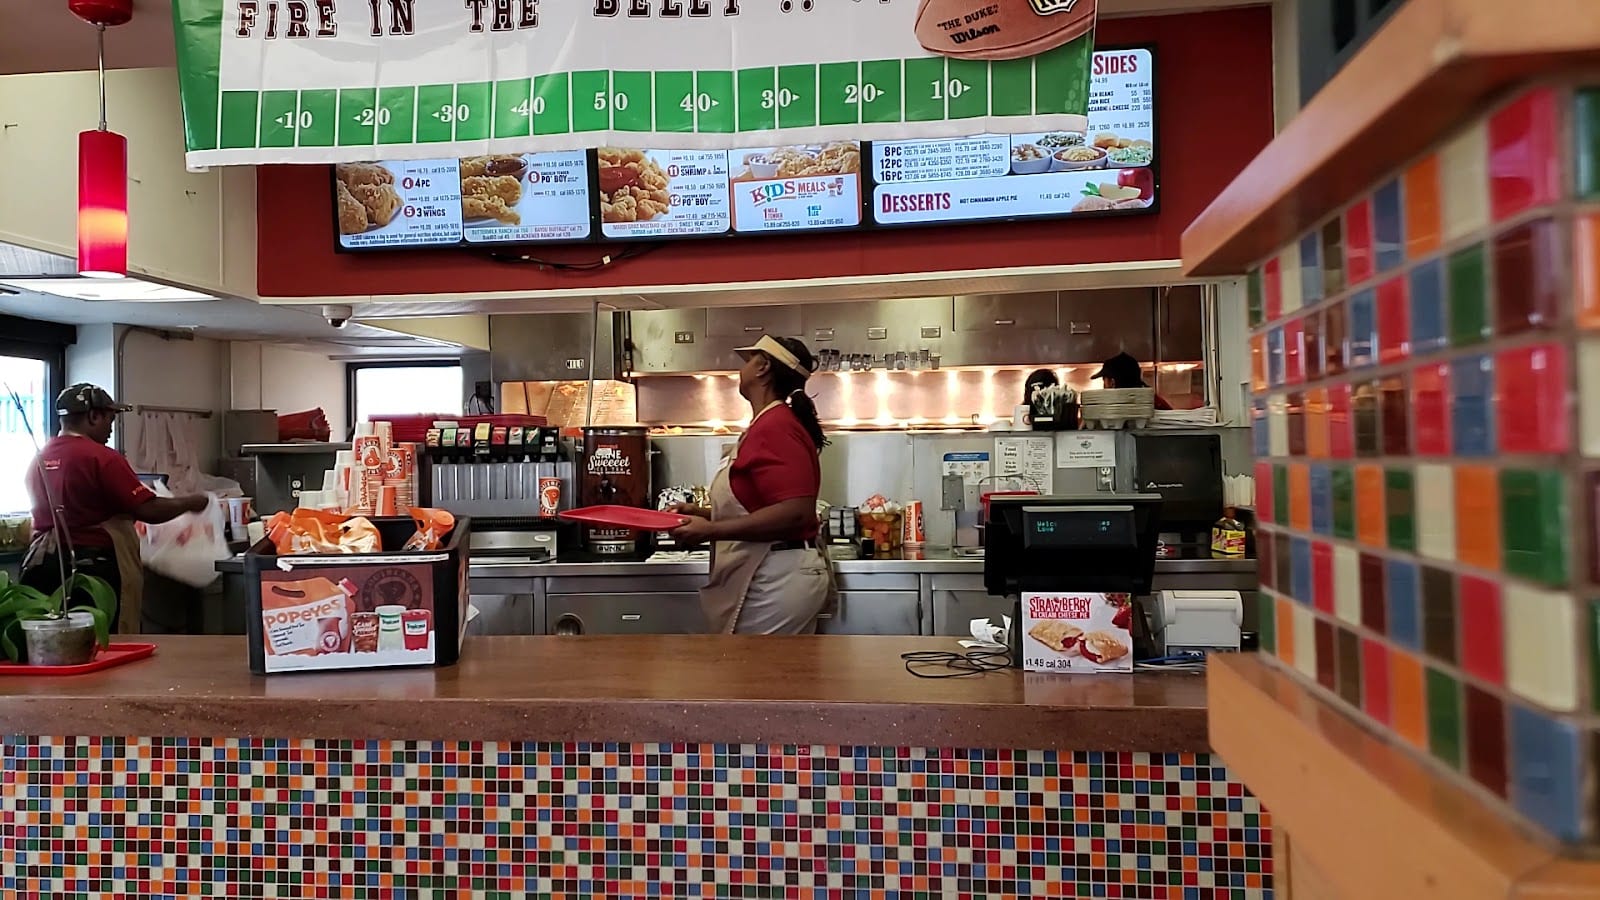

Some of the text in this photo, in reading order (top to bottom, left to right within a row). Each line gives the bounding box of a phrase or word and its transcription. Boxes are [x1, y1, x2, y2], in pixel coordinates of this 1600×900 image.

[236, 0, 337, 39] FIRE
[369, 0, 415, 36] IN
[465, 0, 539, 33] THE
[950, 24, 1000, 44] Wilson
[1093, 54, 1137, 75] SIDES
[283, 78, 962, 129] 10 20 30 40 50 40 30 20 10
[880, 158, 902, 169] 12PC
[680, 168, 707, 176] SHRIMP
[880, 170, 903, 181] 16PC
[554, 175, 567, 183] BOY
[798, 182, 826, 193] MEALS
[695, 198, 709, 206] BOY
[882, 192, 951, 213] DESSERTS
[416, 207, 422, 217] 3
[423, 209, 446, 217] WINGS
[1029, 596, 1092, 612] STRAWBERRY
[1057, 659, 1072, 668] 304
